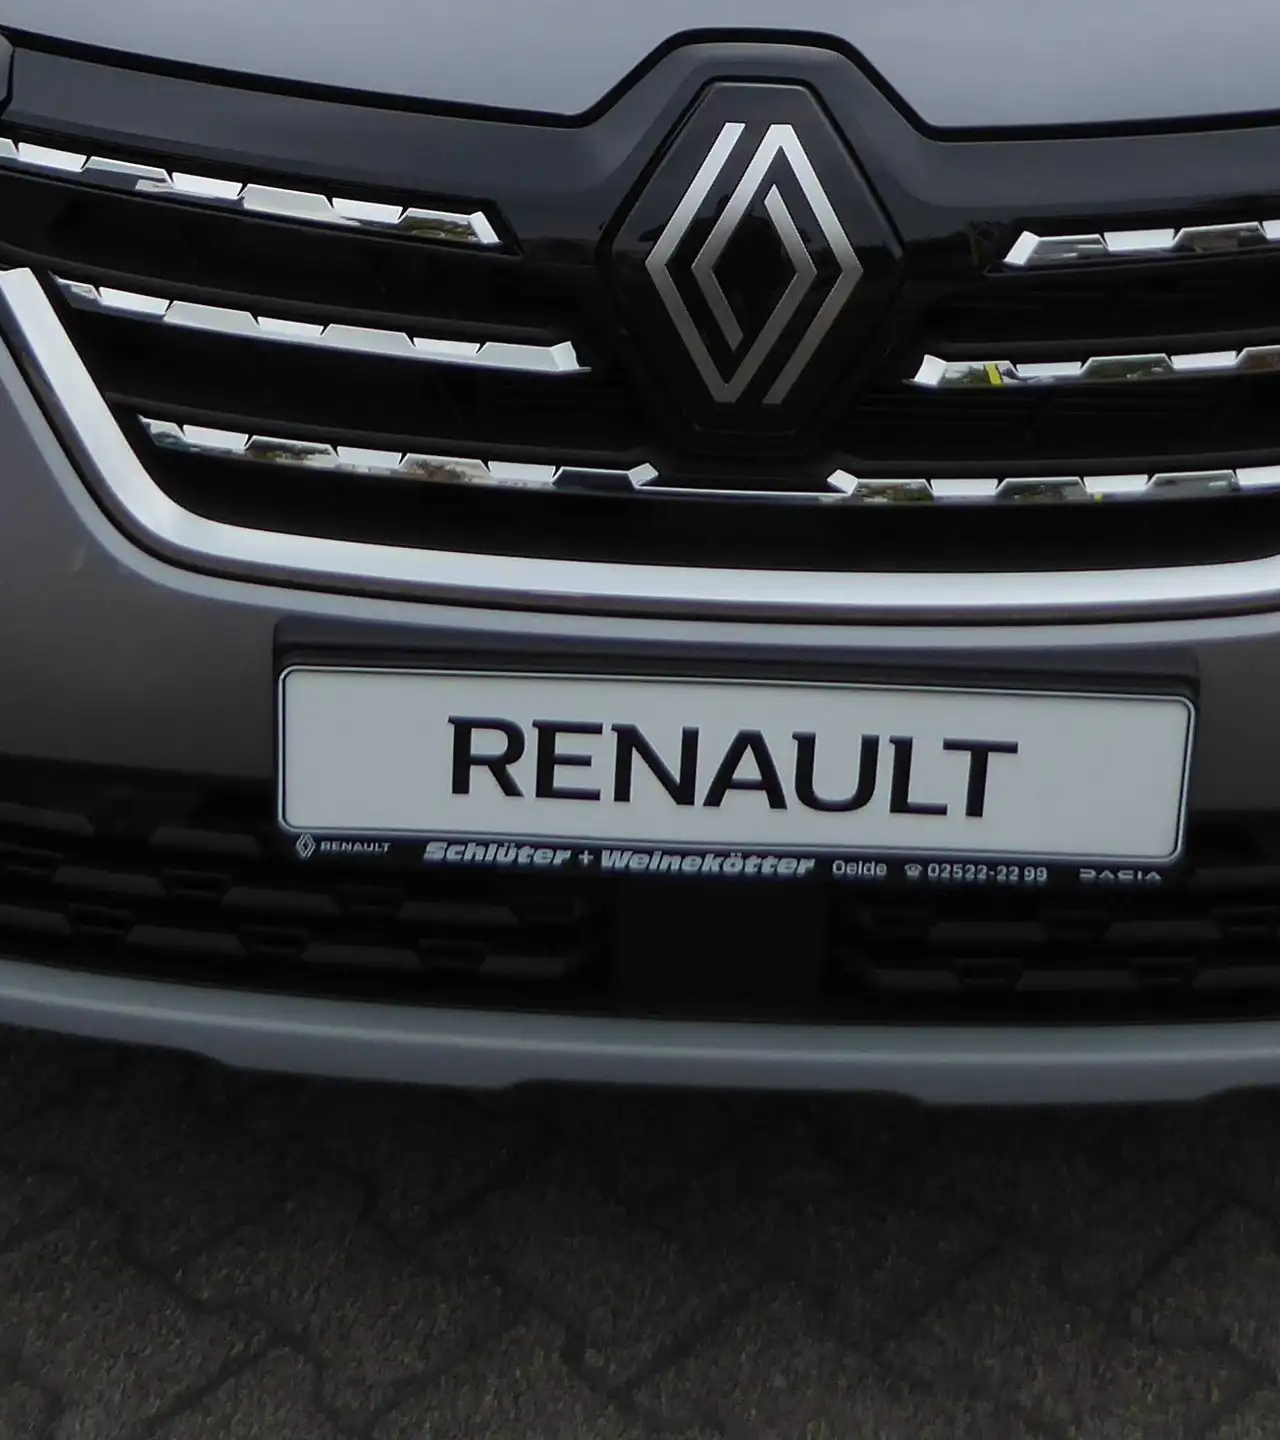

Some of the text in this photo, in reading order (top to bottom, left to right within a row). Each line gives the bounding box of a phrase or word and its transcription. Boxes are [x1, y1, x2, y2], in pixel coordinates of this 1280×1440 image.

[448, 715, 1019, 818] RENAULT
[320, 840, 390, 853] RENAULT
[424, 840, 571, 866] Schlüter
[579, 850, 593, 867] +
[600, 848, 816, 876] Weinekötter
[832, 860, 887, 876] Oelde
